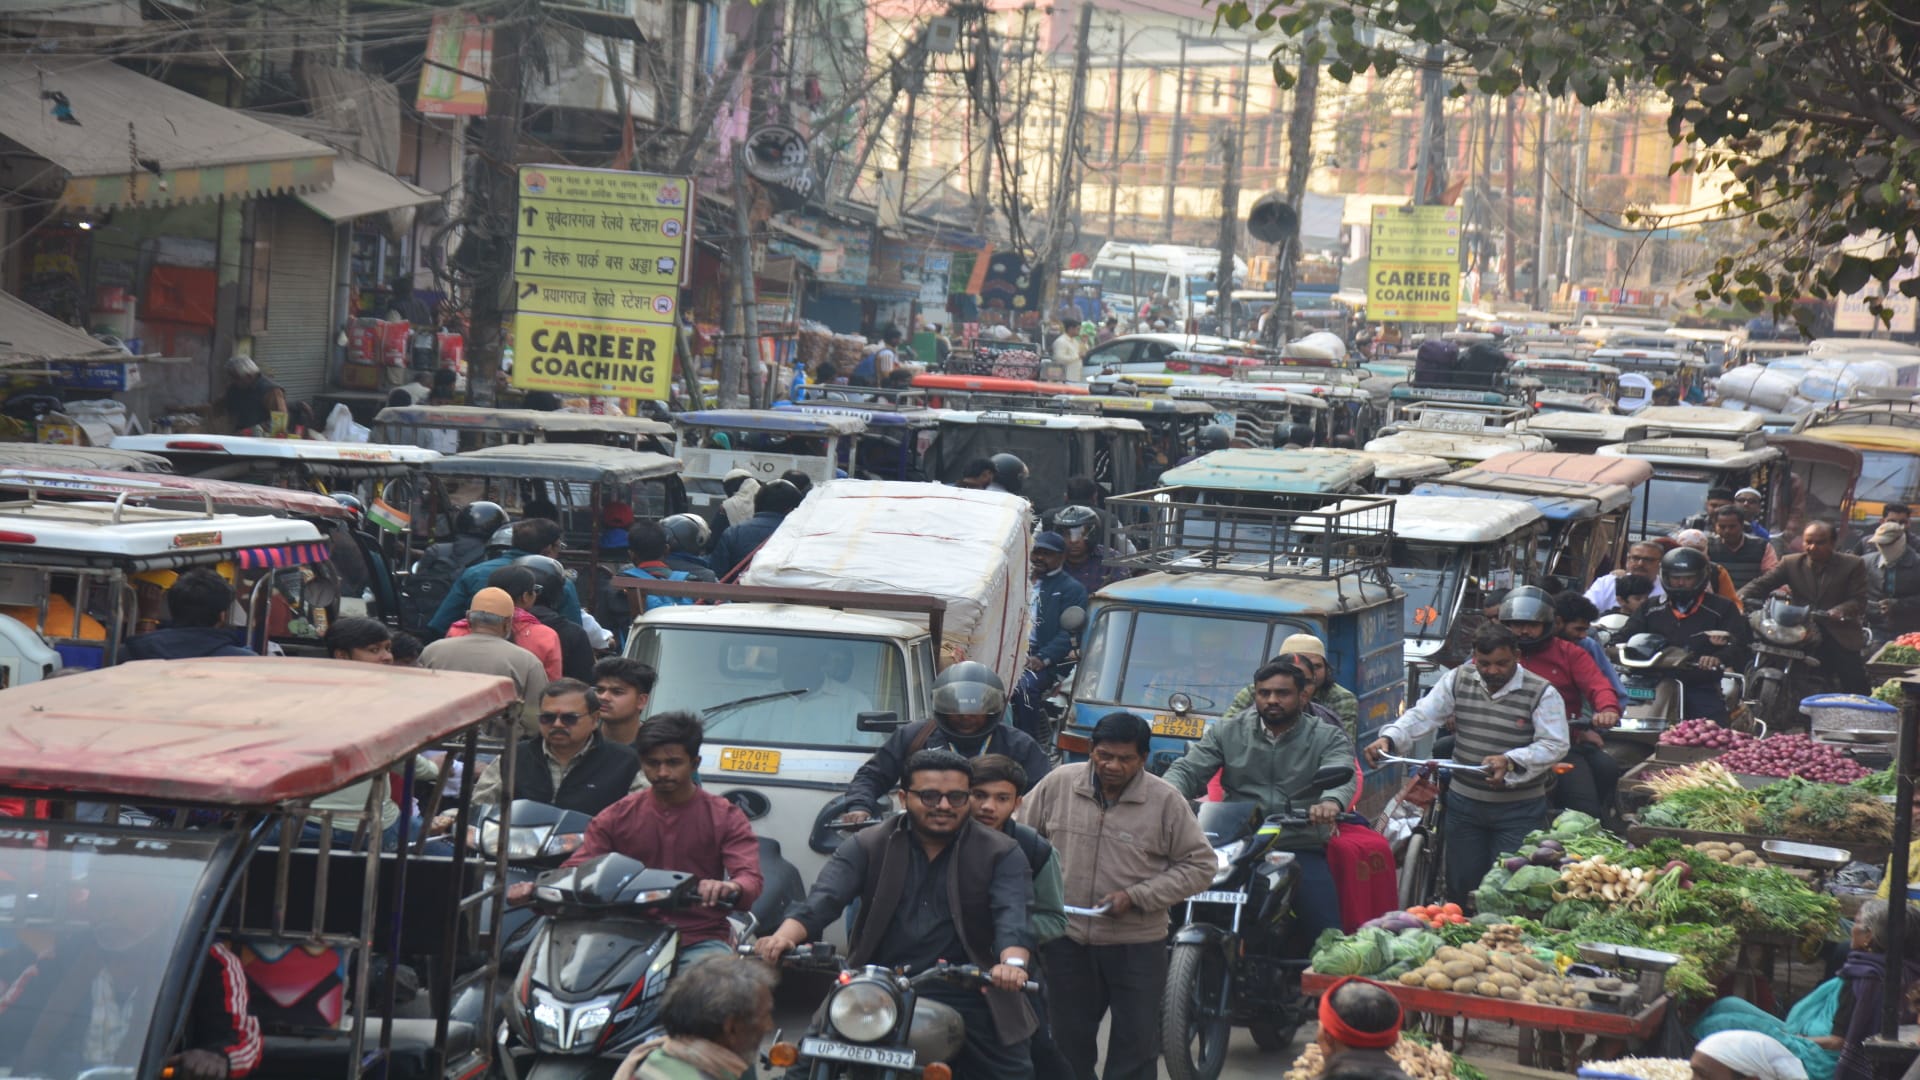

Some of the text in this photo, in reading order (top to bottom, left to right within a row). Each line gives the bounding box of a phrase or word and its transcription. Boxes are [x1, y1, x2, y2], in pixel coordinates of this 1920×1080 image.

[545, 208, 659, 233] सूबेदारगंज रेलवे स्टेशन
[543, 246, 652, 275] नेहरू पार्क बस अड्डा
[1375, 271, 1451, 287] CAREER
[542, 286, 651, 310] प्रयागराज रेलवे स्टेशन
[1375, 289, 1451, 302] COACHING
[531, 328, 656, 362] CAREER
[530, 356, 654, 384] COACHING
[731, 750, 770, 761] UP70H
[817, 1042, 834, 1054] UP
